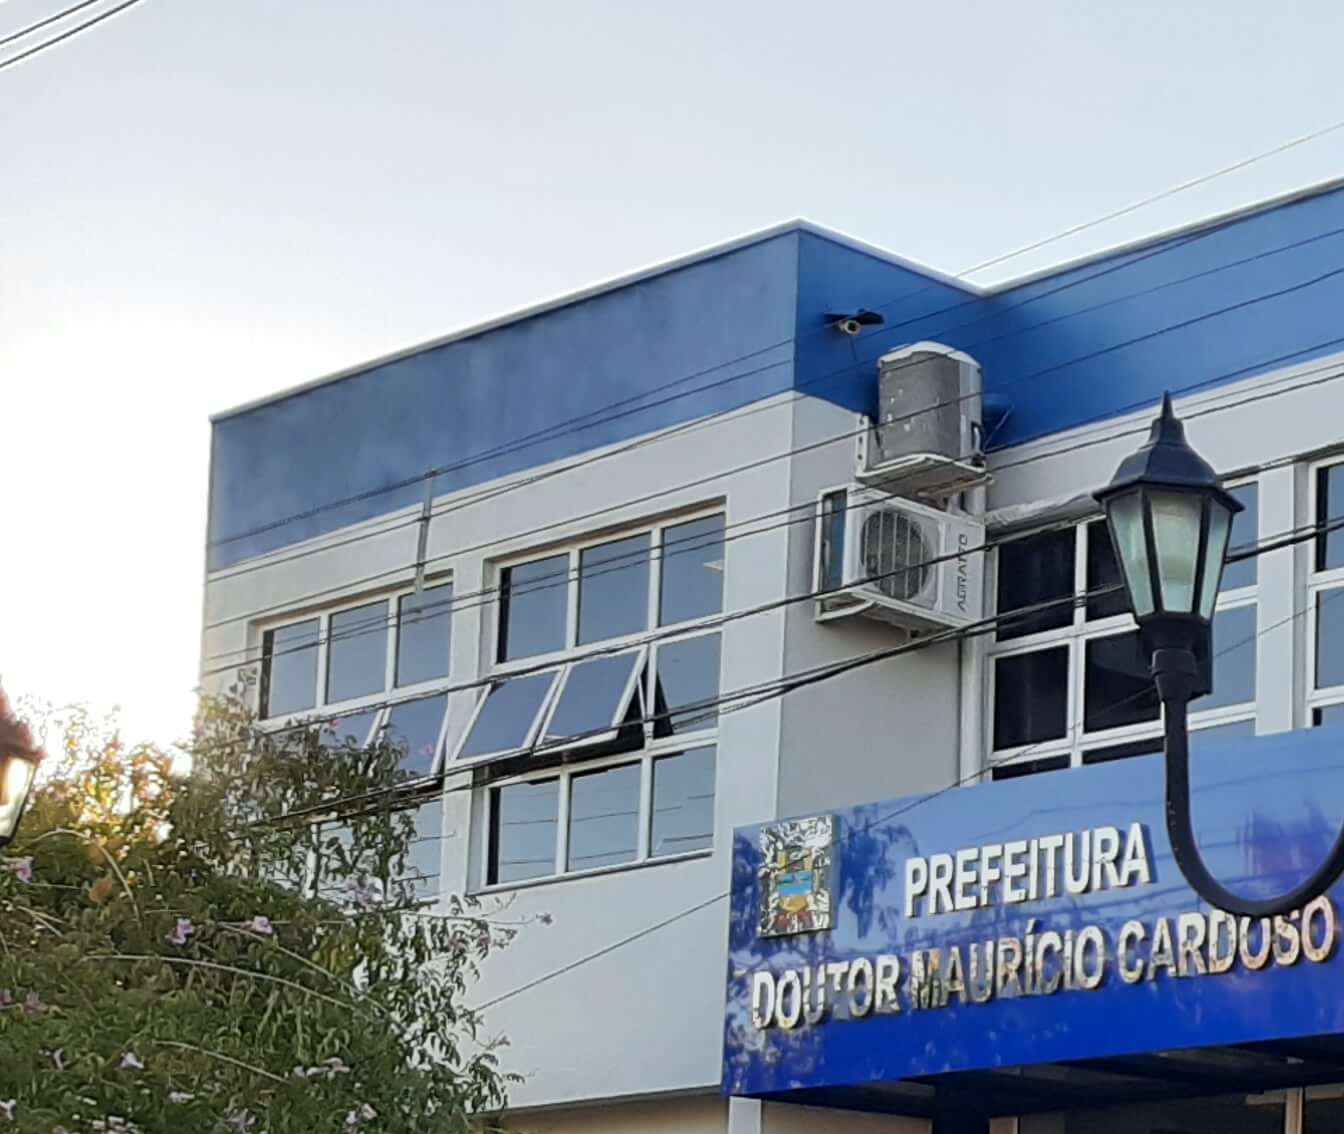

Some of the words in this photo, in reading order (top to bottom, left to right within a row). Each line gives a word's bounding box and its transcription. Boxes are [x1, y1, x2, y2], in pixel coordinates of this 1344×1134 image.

[904, 821, 1151, 918] PREFEITURA
[751, 953, 901, 1030] DOUTOR
[910, 917, 1106, 1010] MAURÍCIO
[1117, 894, 1336, 984] CARDOSO
